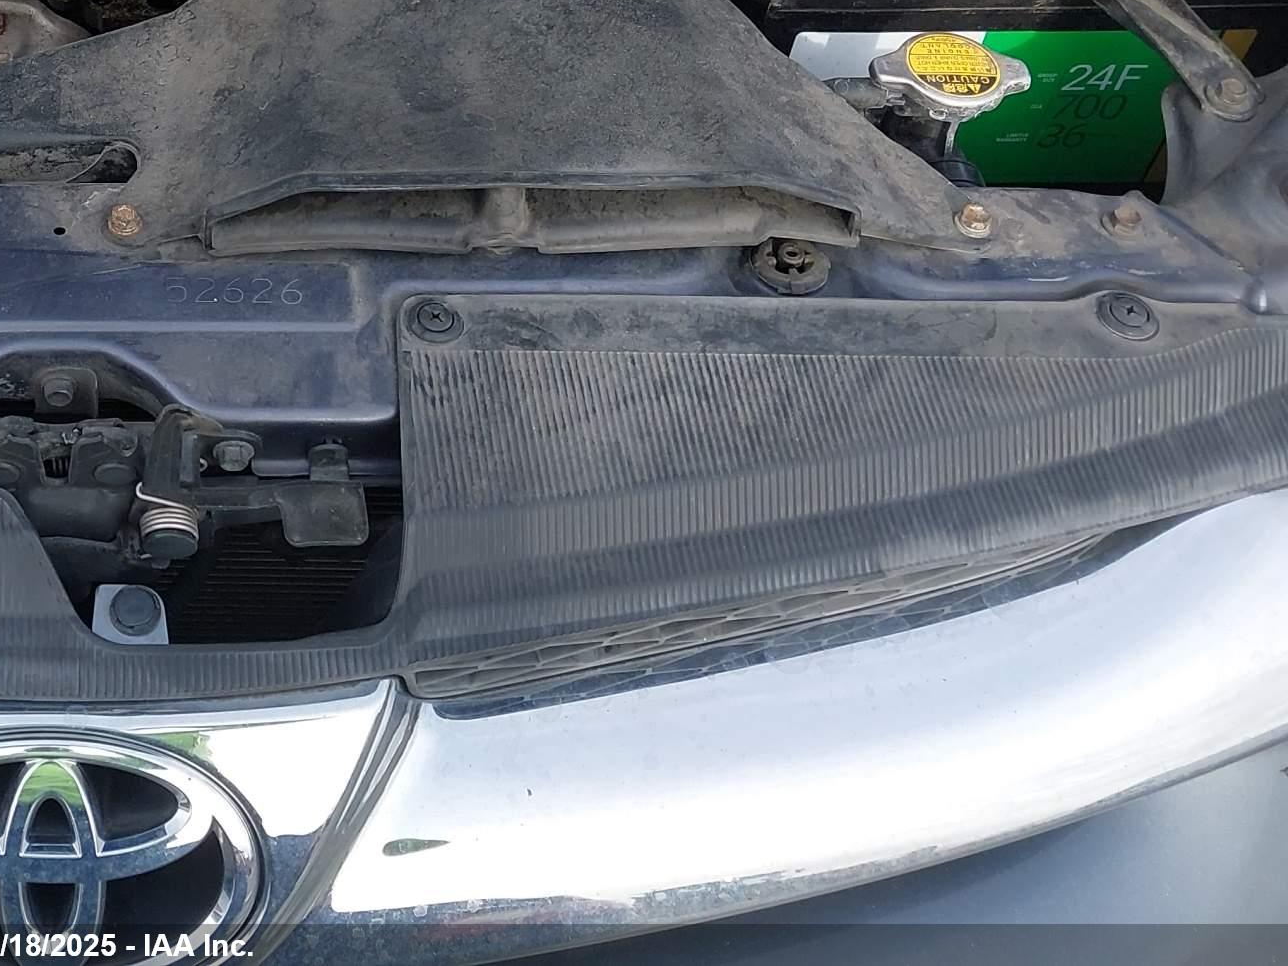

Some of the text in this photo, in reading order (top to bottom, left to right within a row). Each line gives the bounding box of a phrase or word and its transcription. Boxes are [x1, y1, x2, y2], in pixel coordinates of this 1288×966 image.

[927, 74, 990, 84] CAUTION
[1060, 64, 1148, 91] 24F
[1054, 94, 1127, 120] 700
[1037, 123, 1088, 148] 36
[165, 275, 304, 306] 52626
